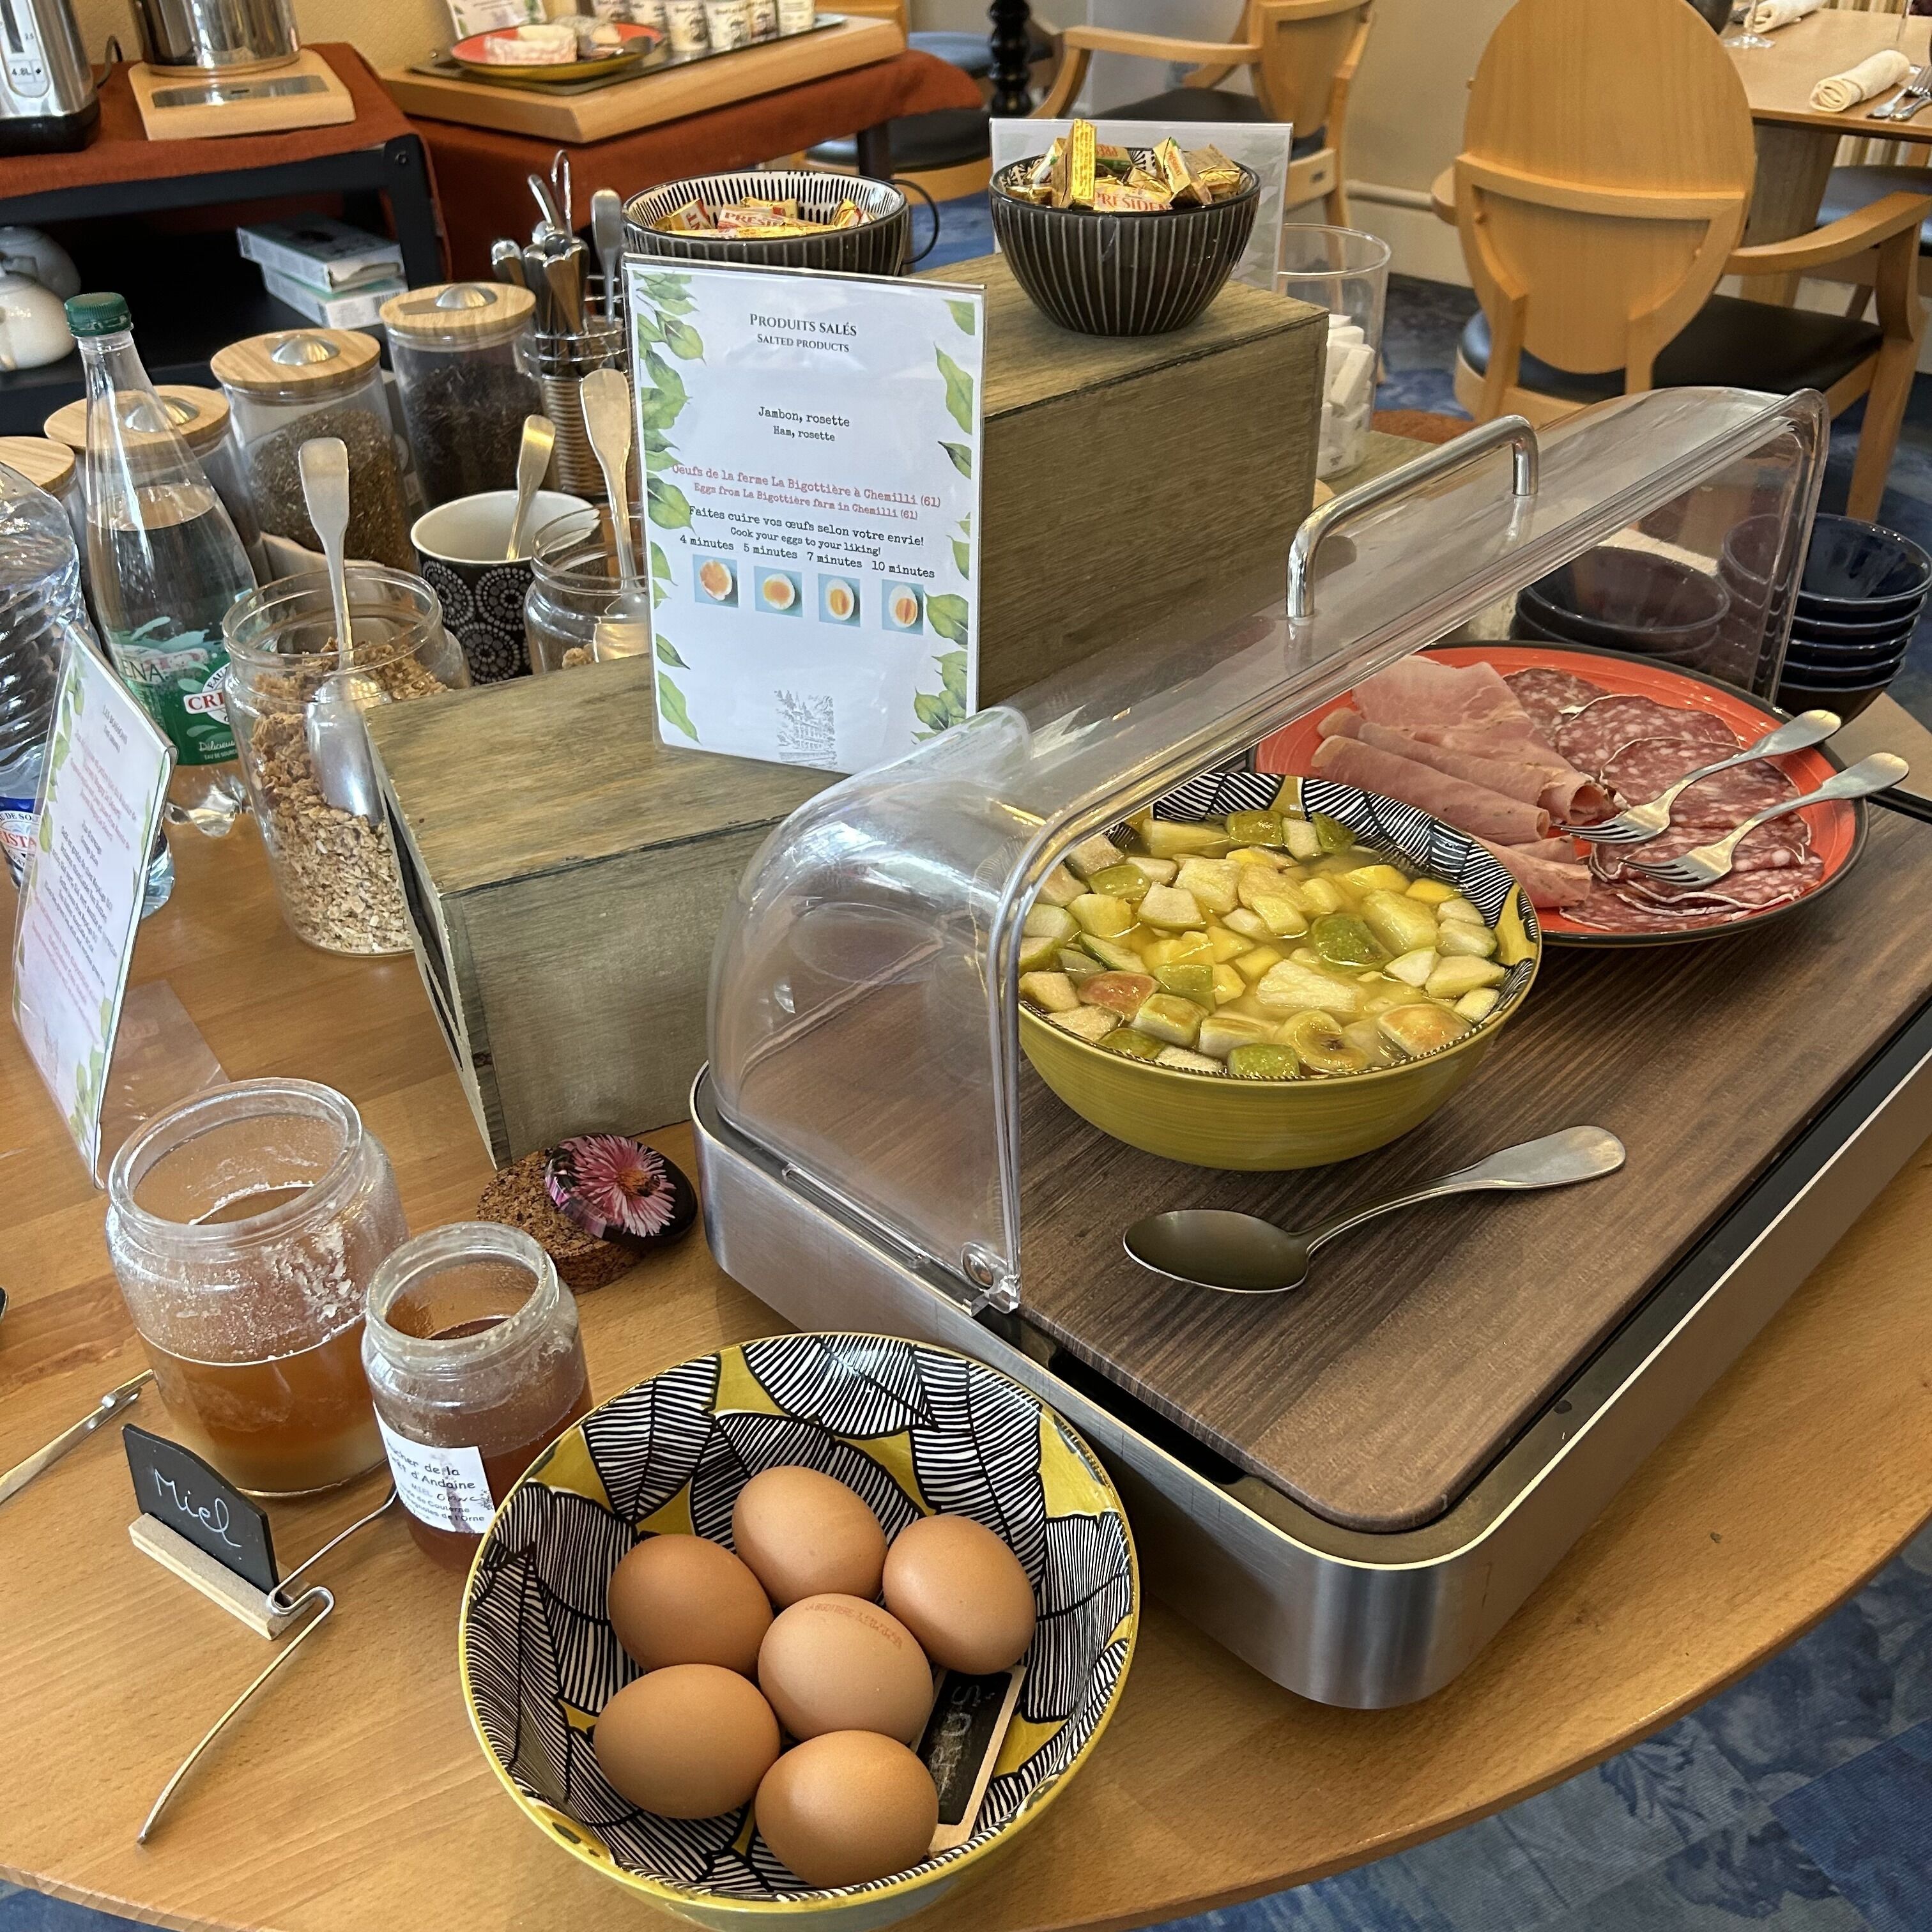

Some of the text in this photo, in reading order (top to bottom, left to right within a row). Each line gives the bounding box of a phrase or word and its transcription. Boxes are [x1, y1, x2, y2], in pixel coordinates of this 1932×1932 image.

[750, 314, 856, 336] PRODUITS SALÉS
[757, 334, 849, 352] SALTED PRODUCTS
[758, 406, 850, 427] Jambon, rosette
[773, 425, 834, 441] Ham, rosette
[706, 468, 718, 479] de
[721, 470, 734, 480] la
[737, 472, 768, 485] ferme
[772, 476, 785, 487] La
[787, 479, 850, 496] Bigottière
[854, 487, 861, 497] à
[921, 495, 940, 507] (61)
[694, 482, 716, 494] Eggs
[719, 486, 740, 496] from
[742, 488, 754, 498] La
[756, 491, 810, 506] Bigottière
[813, 498, 835, 509] farm
[838, 502, 850, 511] in
[901, 509, 917, 520] (61)
[689, 507, 725, 517] Faites
[728, 513, 760, 524] cuire
[763, 518, 782, 526] vos
[818, 525, 850, 537] selon
[851, 530, 884, 541] votre
[887, 535, 924, 546] envie!
[731, 527, 880, 556] Cook your eggs to your liking!
[680, 534, 935, 578] 4 minutes 5 minutes 7 minutes 10 minutes
[188, 692, 224, 710] CRI
[424, 1463, 441, 1474] de
[447, 1466, 460, 1476] la
[155, 1469, 242, 1547] Miel
